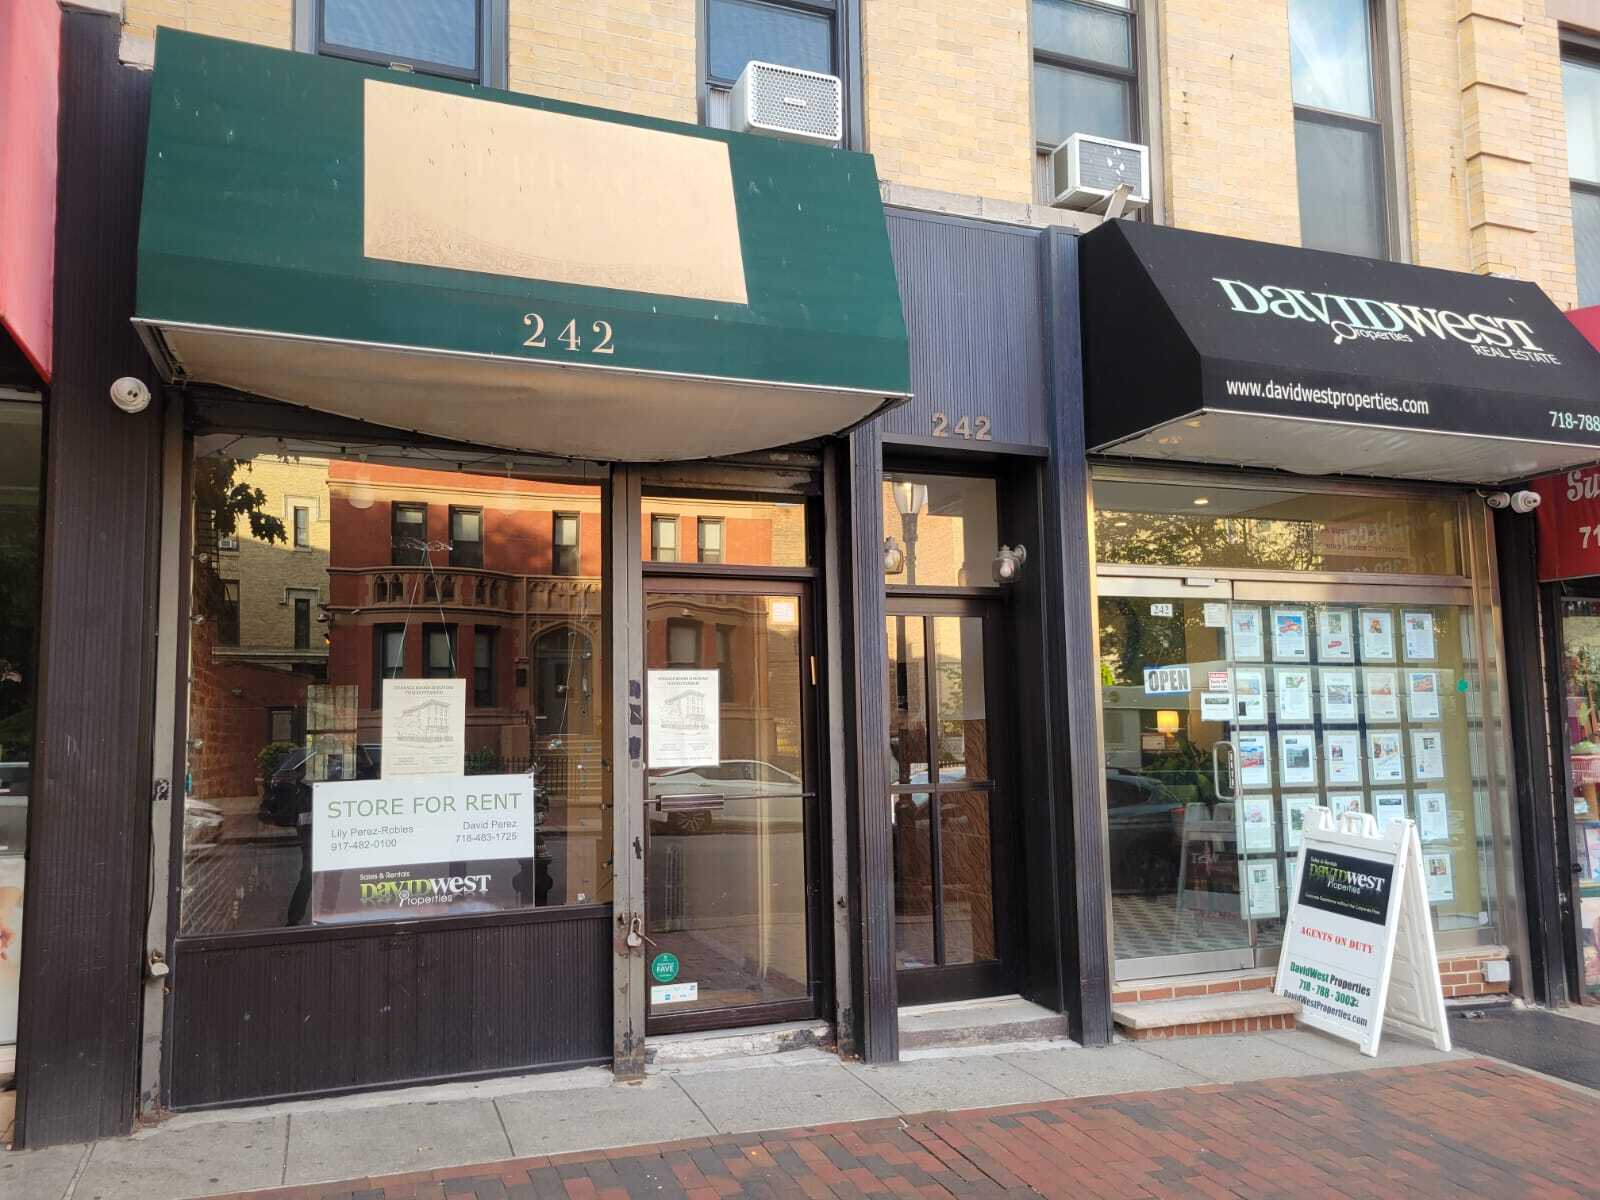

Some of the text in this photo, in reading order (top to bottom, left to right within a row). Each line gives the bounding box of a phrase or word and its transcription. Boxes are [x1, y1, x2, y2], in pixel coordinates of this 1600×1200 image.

[523, 313, 615, 354] 242
[1471, 344, 1562, 365] REAL ESTATE
[1226, 380, 1429, 415] www.davidwestproperties.com
[931, 411, 993, 441] 242
[1148, 669, 1189, 692] OPEN
[327, 792, 522, 819] STORE FOR RENT
[331, 828, 348, 840] Lily
[463, 818, 517, 830] David Perez
[1301, 926, 1377, 954] AGENTS ON DUTY
[1290, 961, 1371, 997] DavidWest Properties
